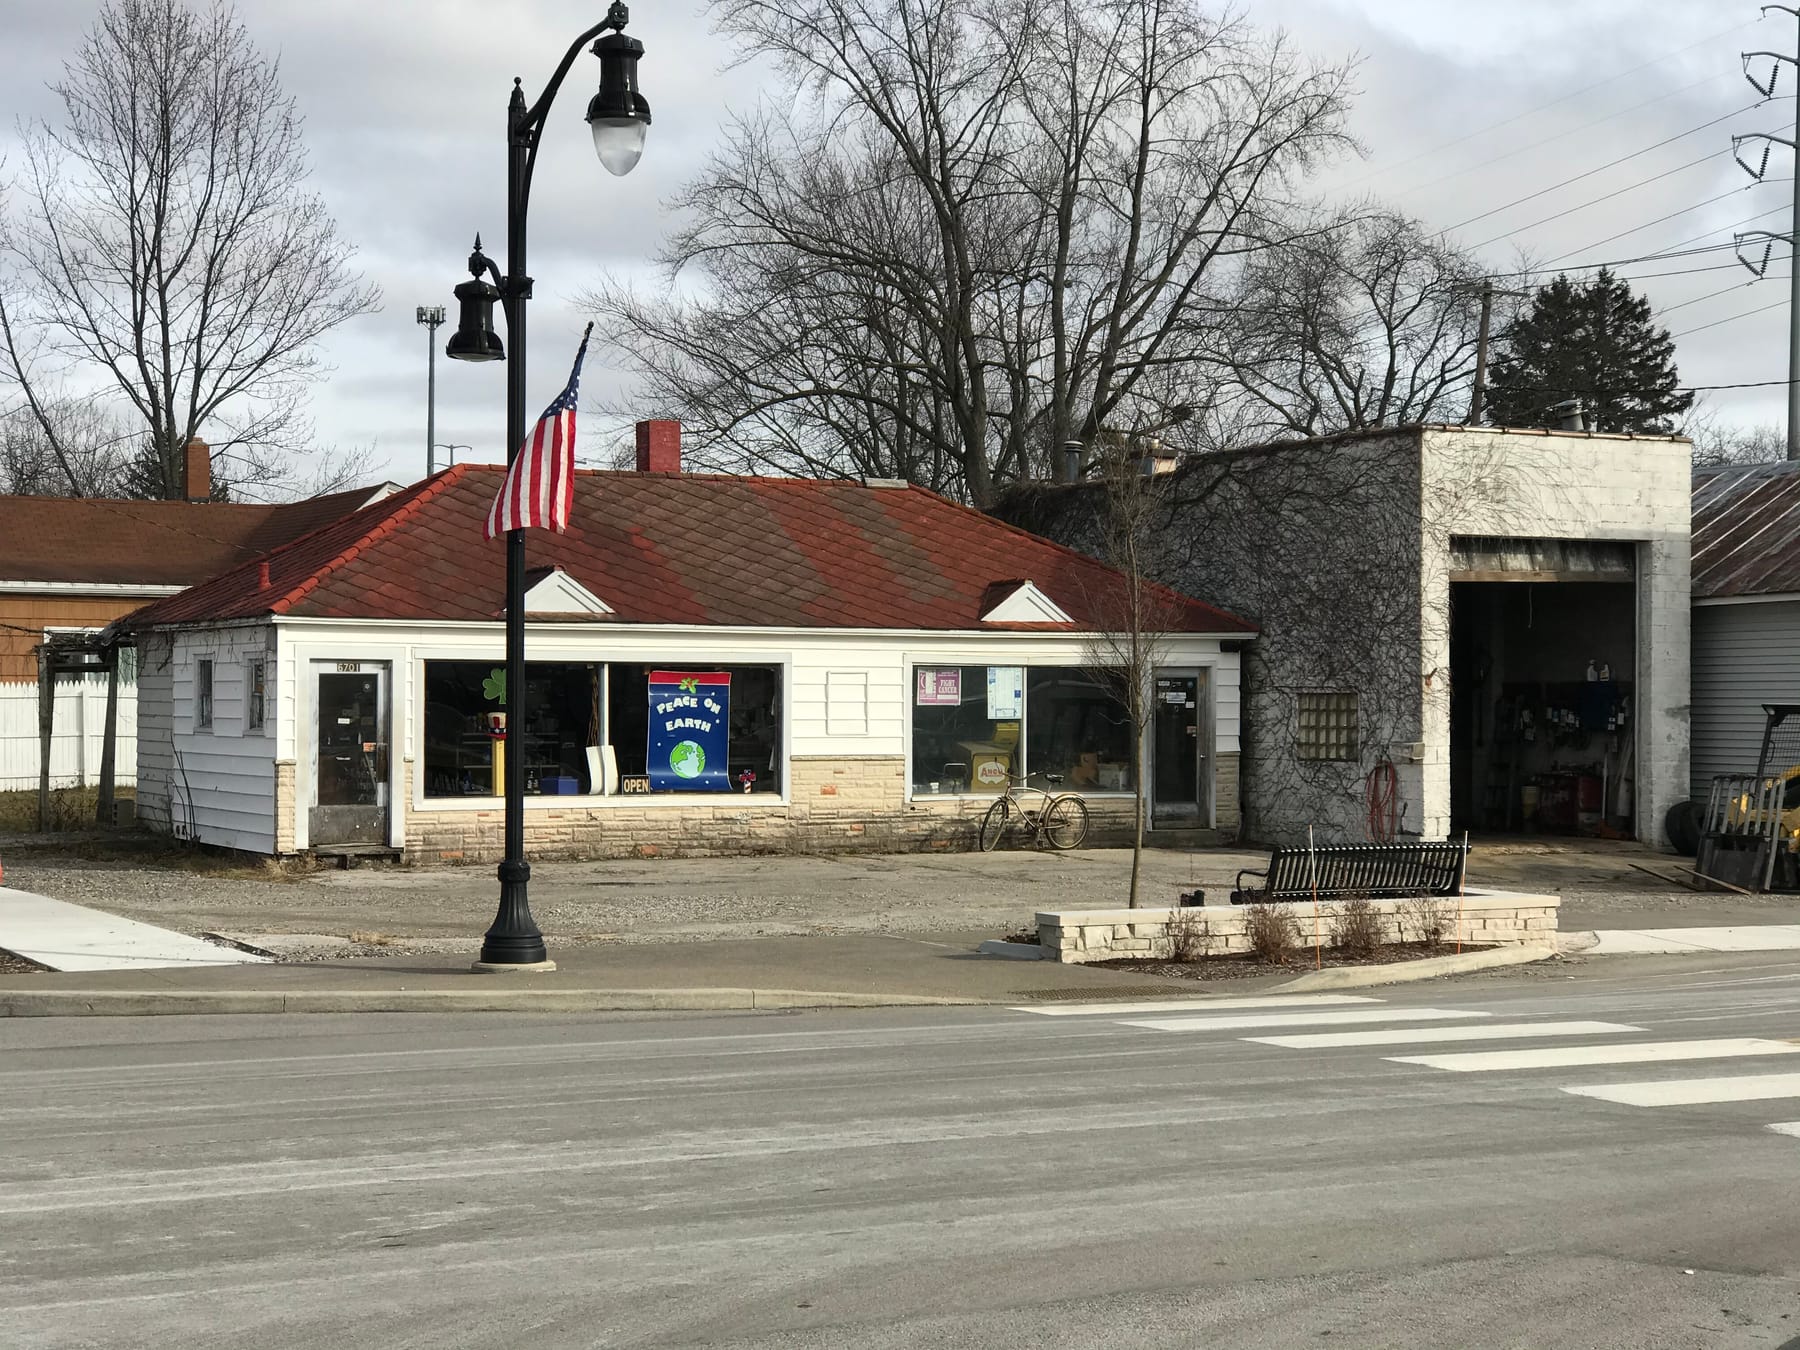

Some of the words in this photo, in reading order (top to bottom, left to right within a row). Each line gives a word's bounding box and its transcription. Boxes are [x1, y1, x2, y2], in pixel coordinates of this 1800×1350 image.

[337, 663, 360, 672] 6701
[656, 695, 698, 714] PEACE
[703, 697, 721, 714] ON
[665, 717, 711, 733] EARTH
[623, 778, 649, 793] OPEN
